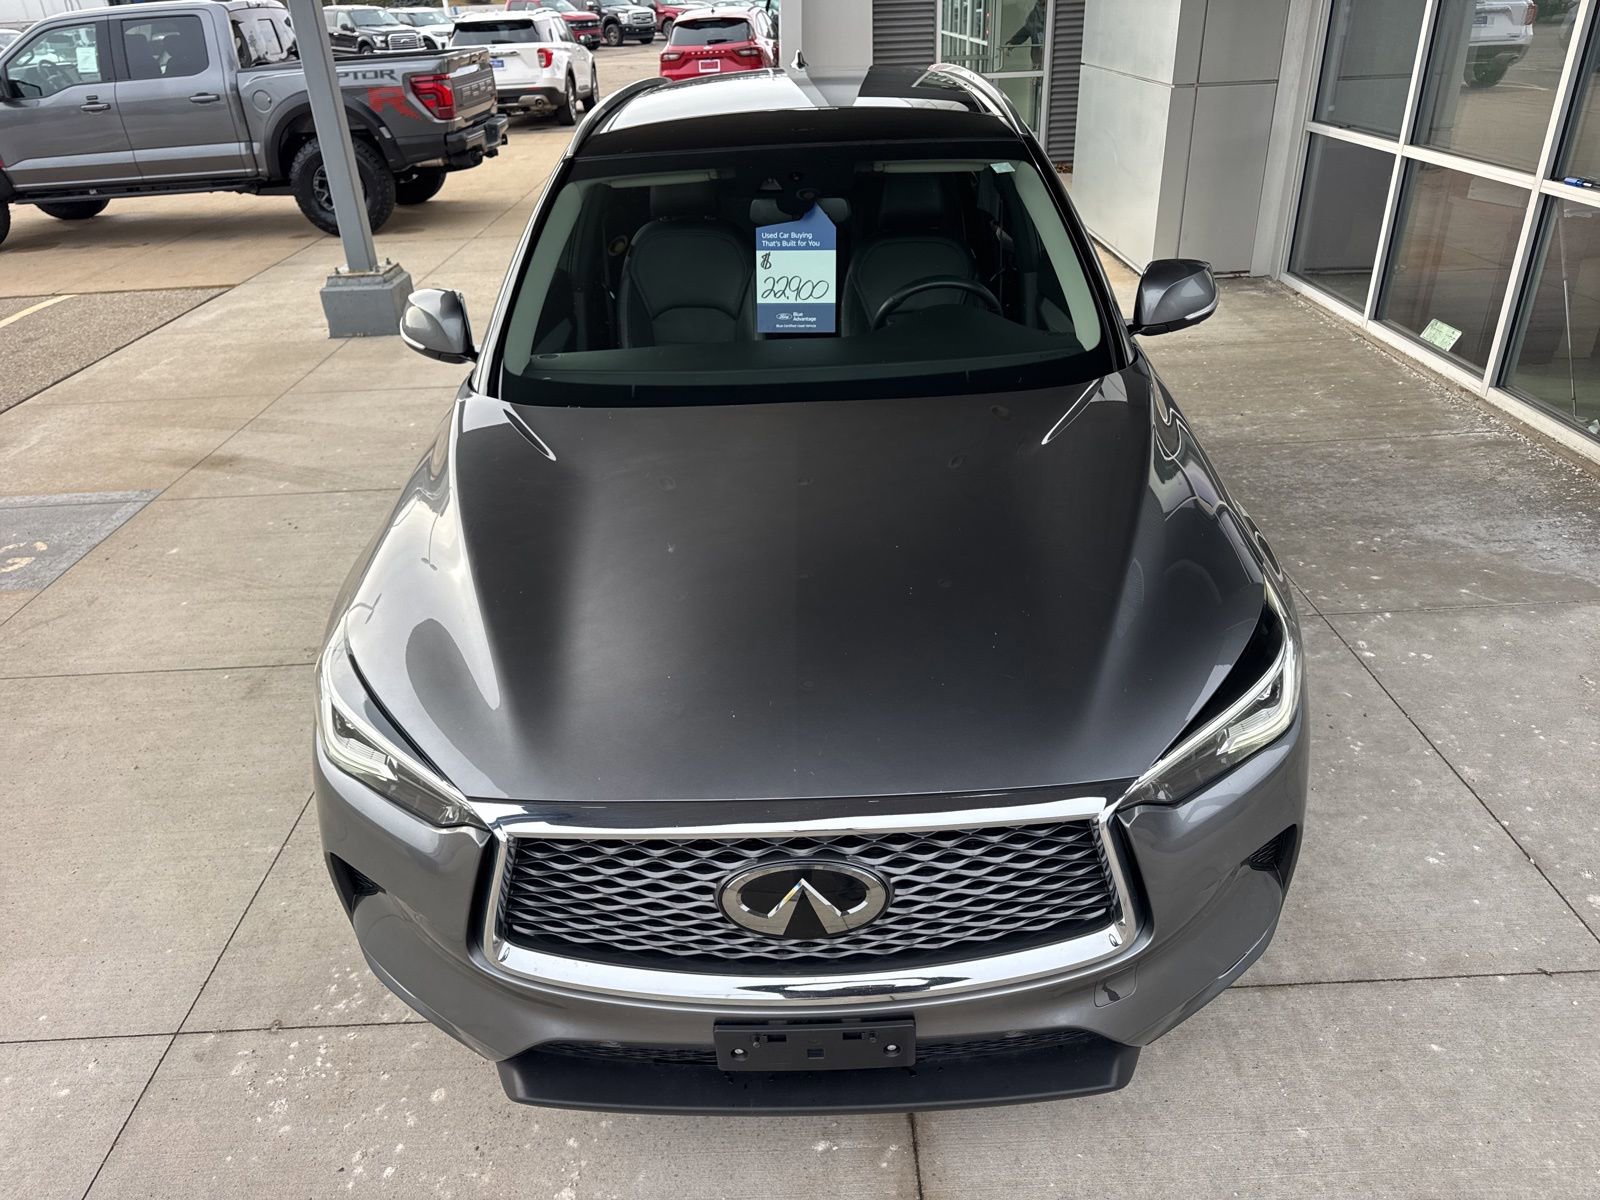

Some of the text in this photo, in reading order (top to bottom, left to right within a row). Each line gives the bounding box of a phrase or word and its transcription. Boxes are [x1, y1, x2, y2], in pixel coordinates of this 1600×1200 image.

[336, 69, 399, 82] PTOR
[790, 232, 813, 240] Buying
[760, 252, 772, 270] $
